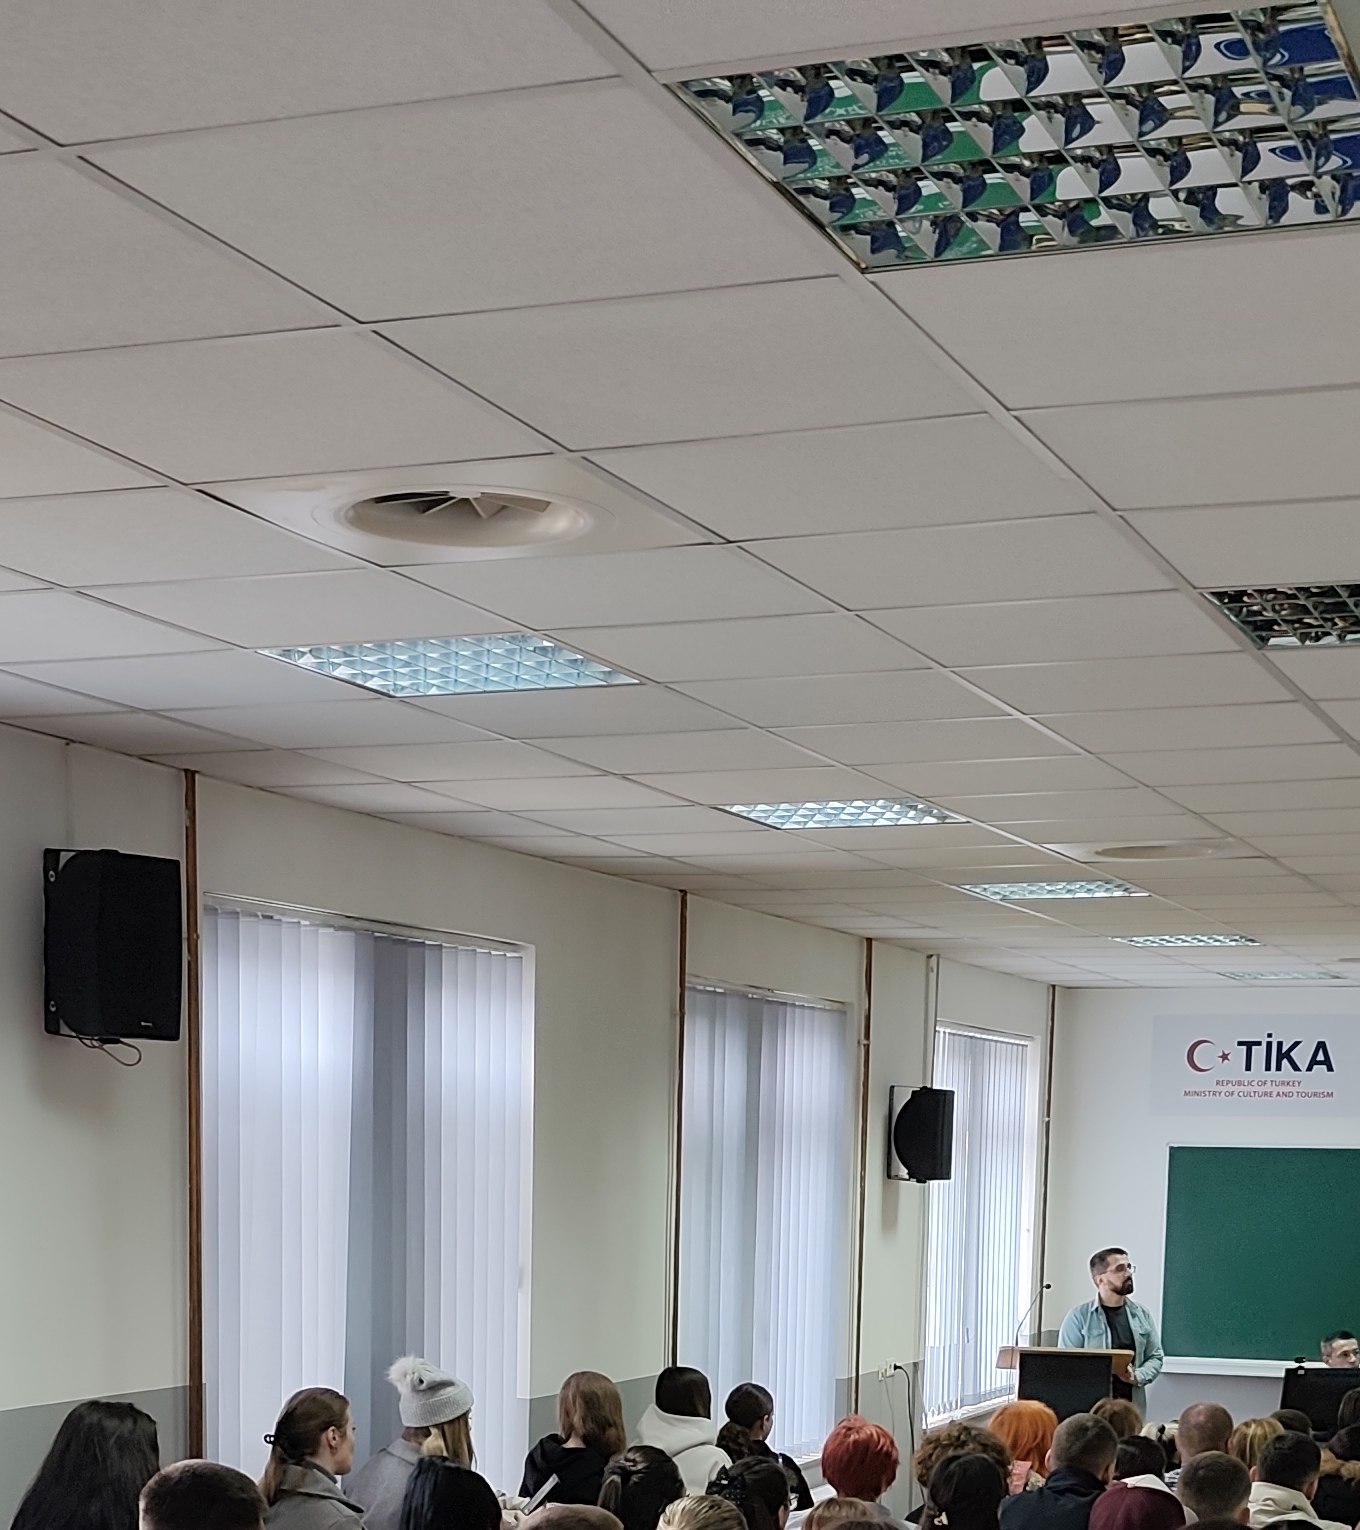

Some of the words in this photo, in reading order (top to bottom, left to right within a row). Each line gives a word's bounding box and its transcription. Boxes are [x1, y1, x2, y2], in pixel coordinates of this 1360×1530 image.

[1236, 1032, 1335, 1072] TİKA
[1215, 1079, 1255, 1087] REPUBLIC
[1270, 1080, 1302, 1088] TURKEY
[1183, 1090, 1222, 1098] MINISTRY
[1224, 1090, 1236, 1098] OF
[1237, 1090, 1274, 1098] CULTURE
[1275, 1090, 1294, 1098] AND
[1296, 1091, 1334, 1099] TOURISM
